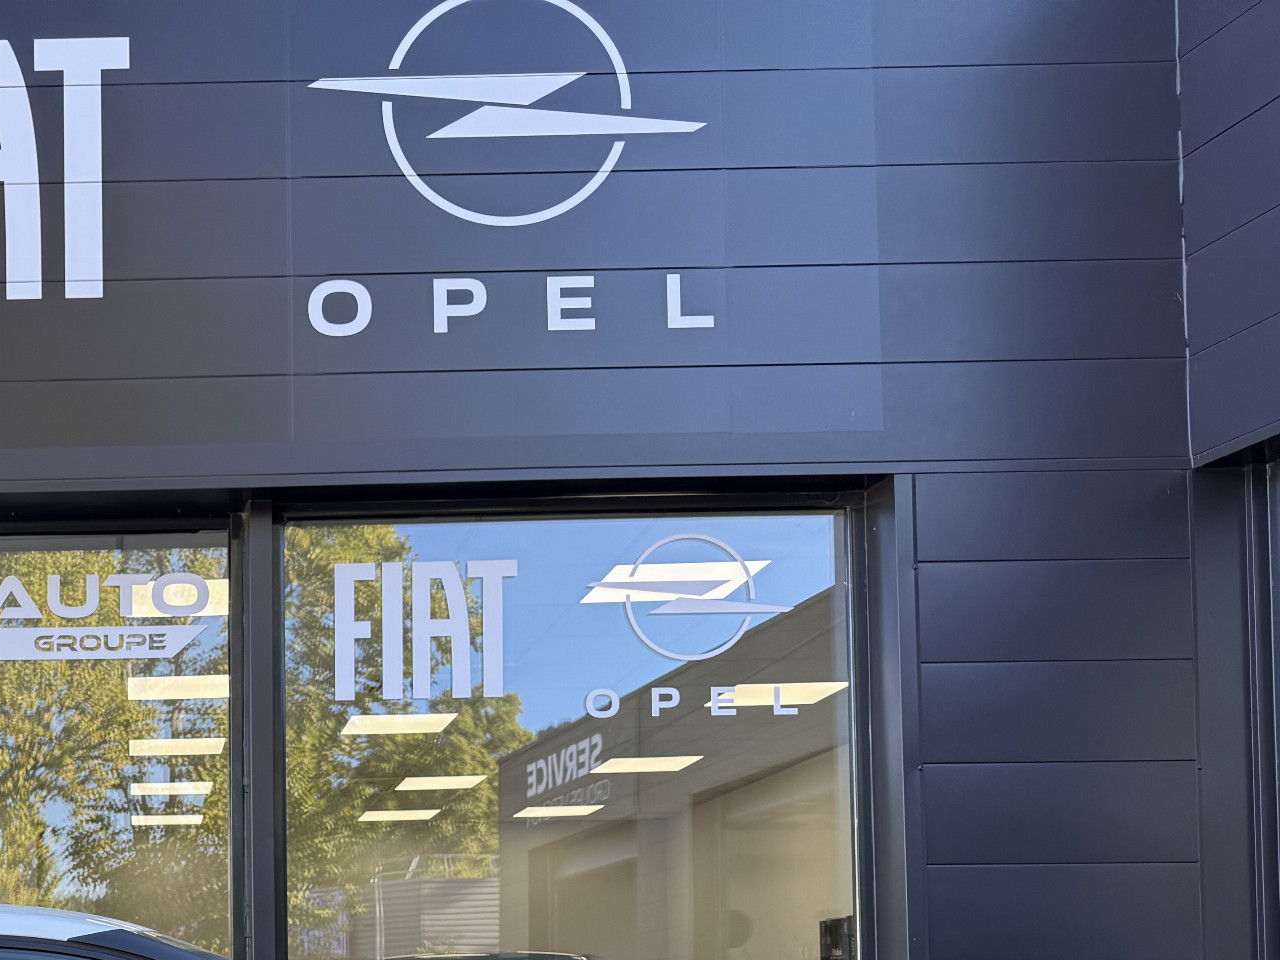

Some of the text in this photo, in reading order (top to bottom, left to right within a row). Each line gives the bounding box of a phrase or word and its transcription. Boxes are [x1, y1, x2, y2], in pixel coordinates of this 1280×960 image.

[307, 273, 715, 336] OPEL
[33, 632, 167, 652] GROUPE
[334, 559, 518, 701] FIAT
[585, 686, 799, 719] OPEL
